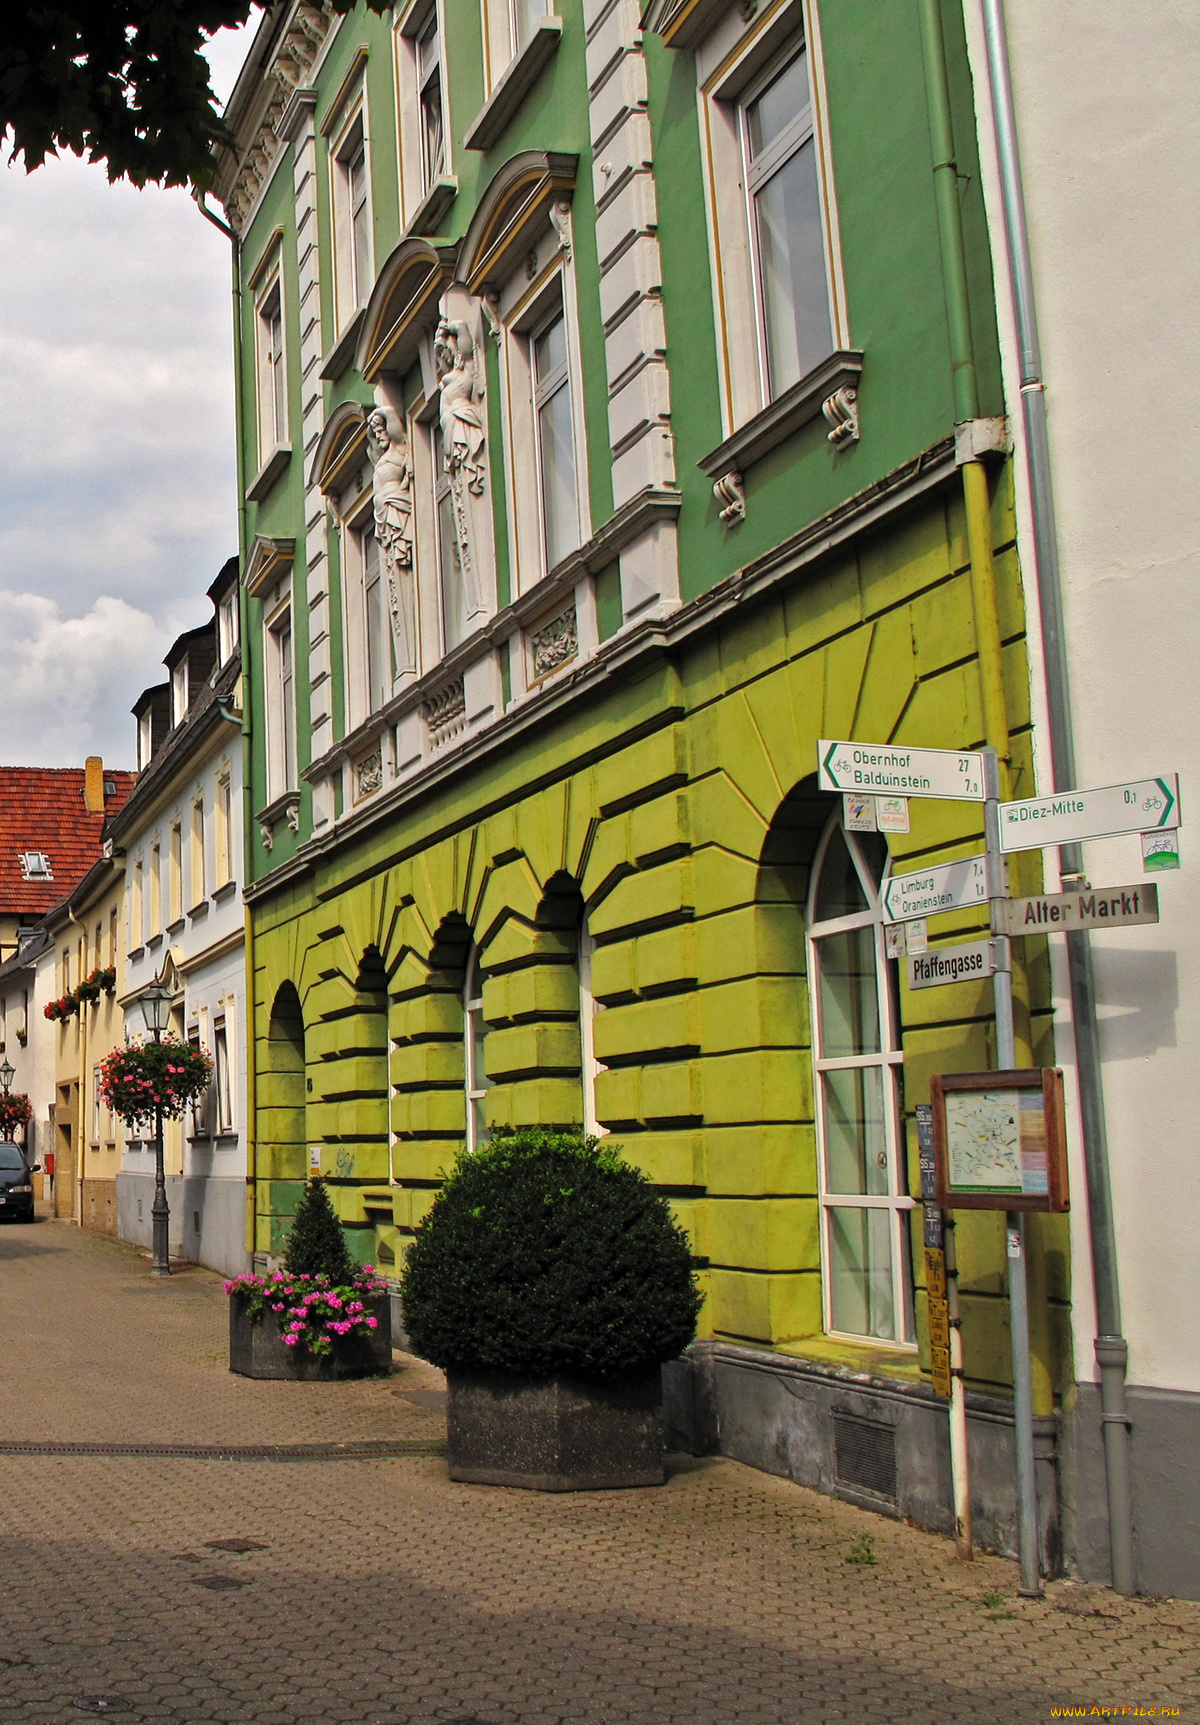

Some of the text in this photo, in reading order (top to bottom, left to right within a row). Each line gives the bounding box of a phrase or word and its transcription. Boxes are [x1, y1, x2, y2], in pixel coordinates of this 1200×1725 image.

[853, 750, 969, 773] Obernhof 27
[854, 770, 930, 789] Balduinstein
[1019, 800, 1084, 821] Diez-Mitte
[901, 878, 934, 895] Limburg
[902, 890, 953, 913] Oranienstein
[1024, 890, 1140, 925] Alter Markt
[913, 952, 983, 981] Pfaffengasse
